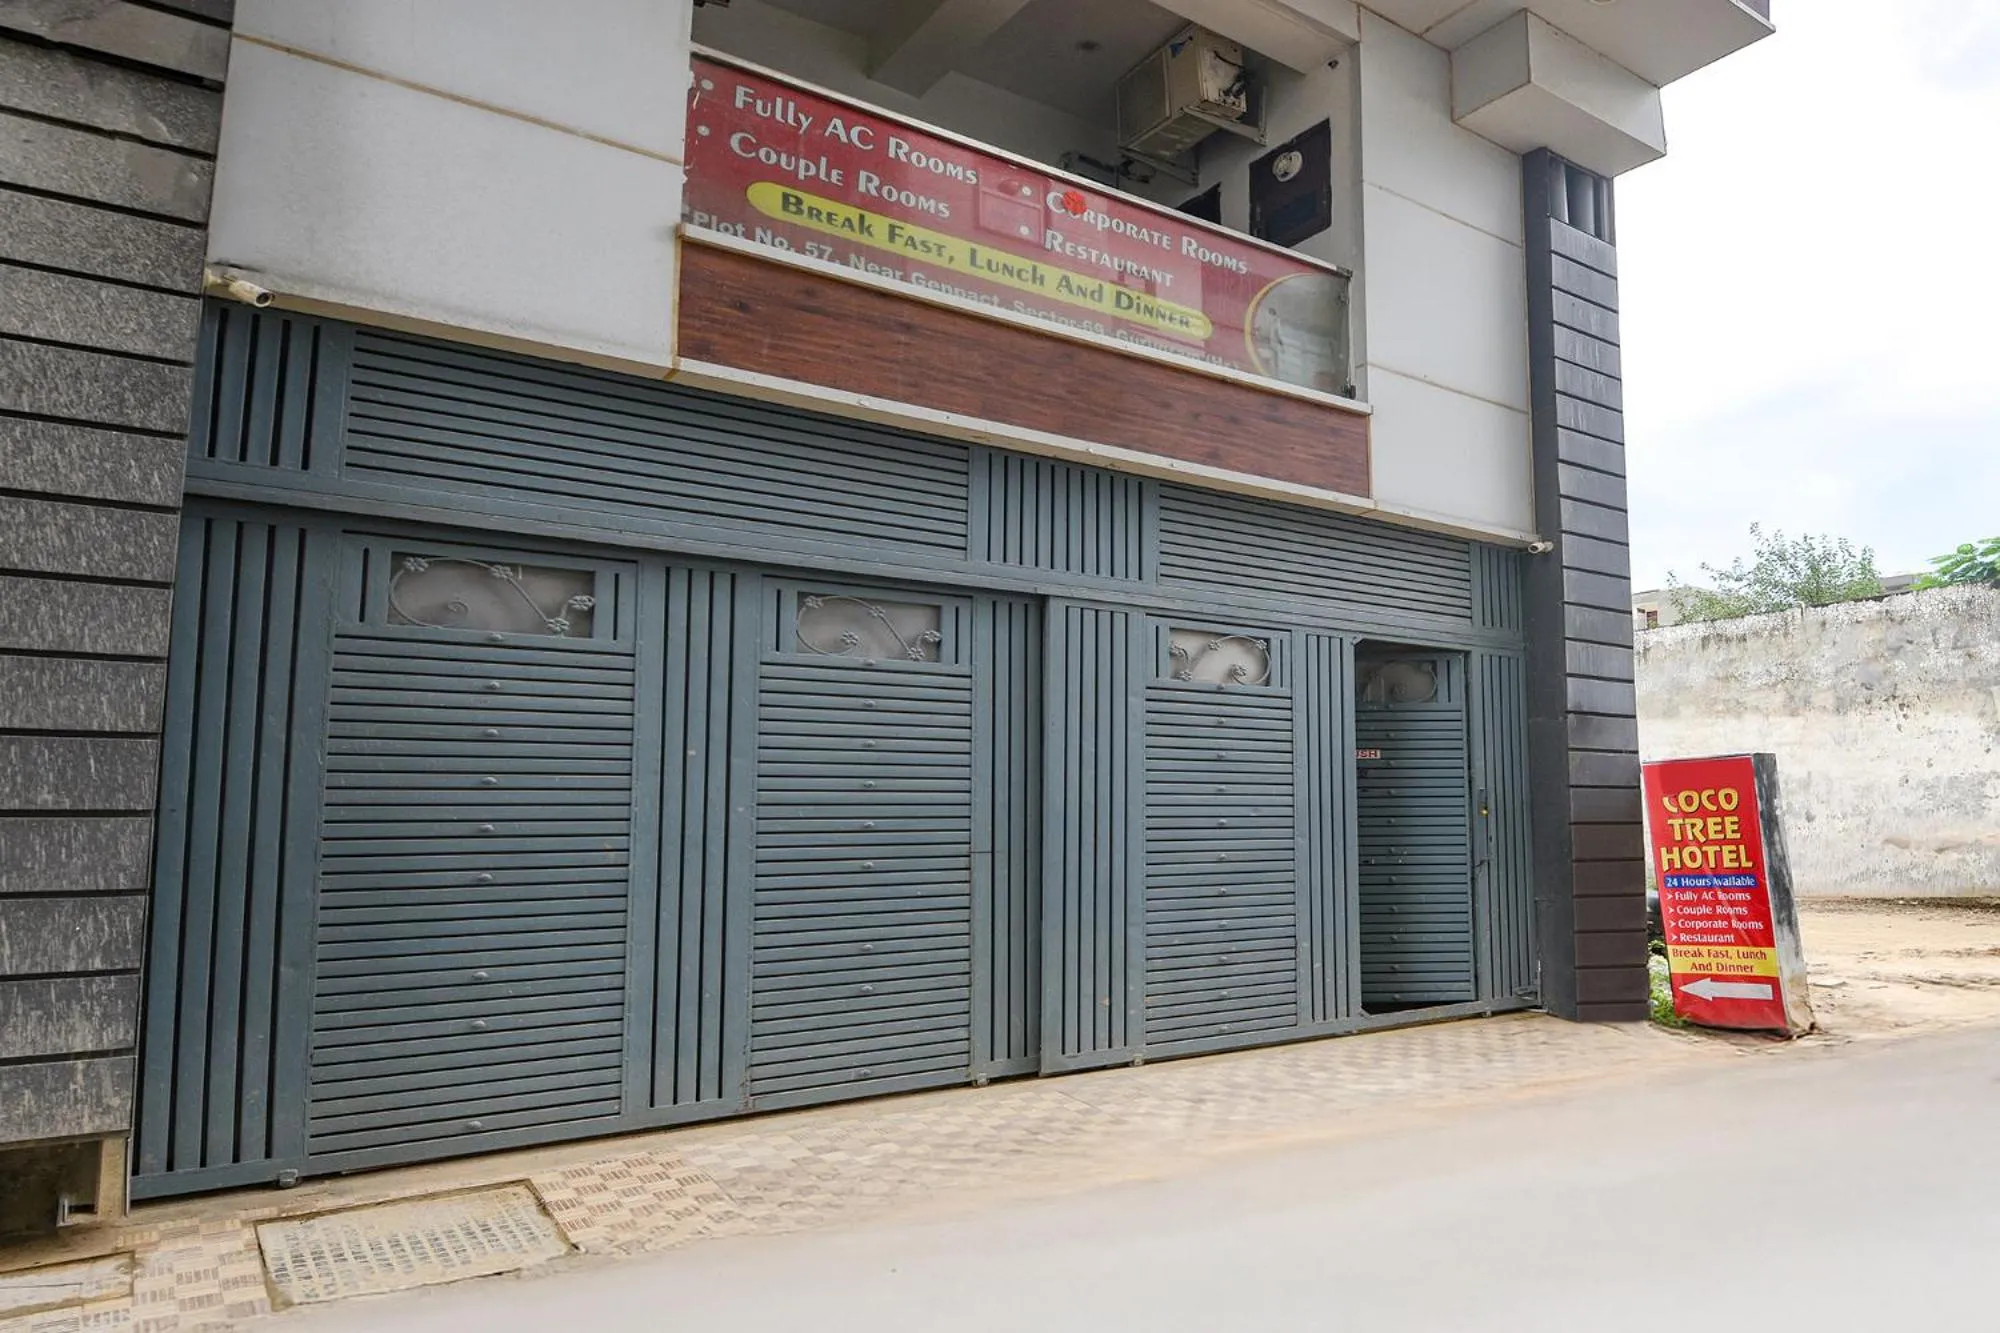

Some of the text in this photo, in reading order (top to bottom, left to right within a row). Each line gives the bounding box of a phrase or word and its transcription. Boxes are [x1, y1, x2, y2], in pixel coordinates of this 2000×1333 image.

[735, 84, 813, 134] Fully
[824, 117, 875, 151] AC
[1662, 787, 1739, 814] COCO
[1667, 816, 1741, 843] TREE
[1660, 844, 1753, 872] HOTEL
[1667, 877, 1679, 888] 24
[1681, 877, 1712, 887] Hours
[1675, 891, 1698, 902] Fully
[1701, 891, 1715, 900] AC
[1676, 905, 1749, 917] Couple Rooms
[1678, 919, 1764, 930] Corporate Rooms
[1680, 932, 1735, 943] Restaurant
[1672, 947, 1705, 958] Break
[1736, 949, 1767, 961] Lunch
[1690, 962, 1755, 973] And Dinner
